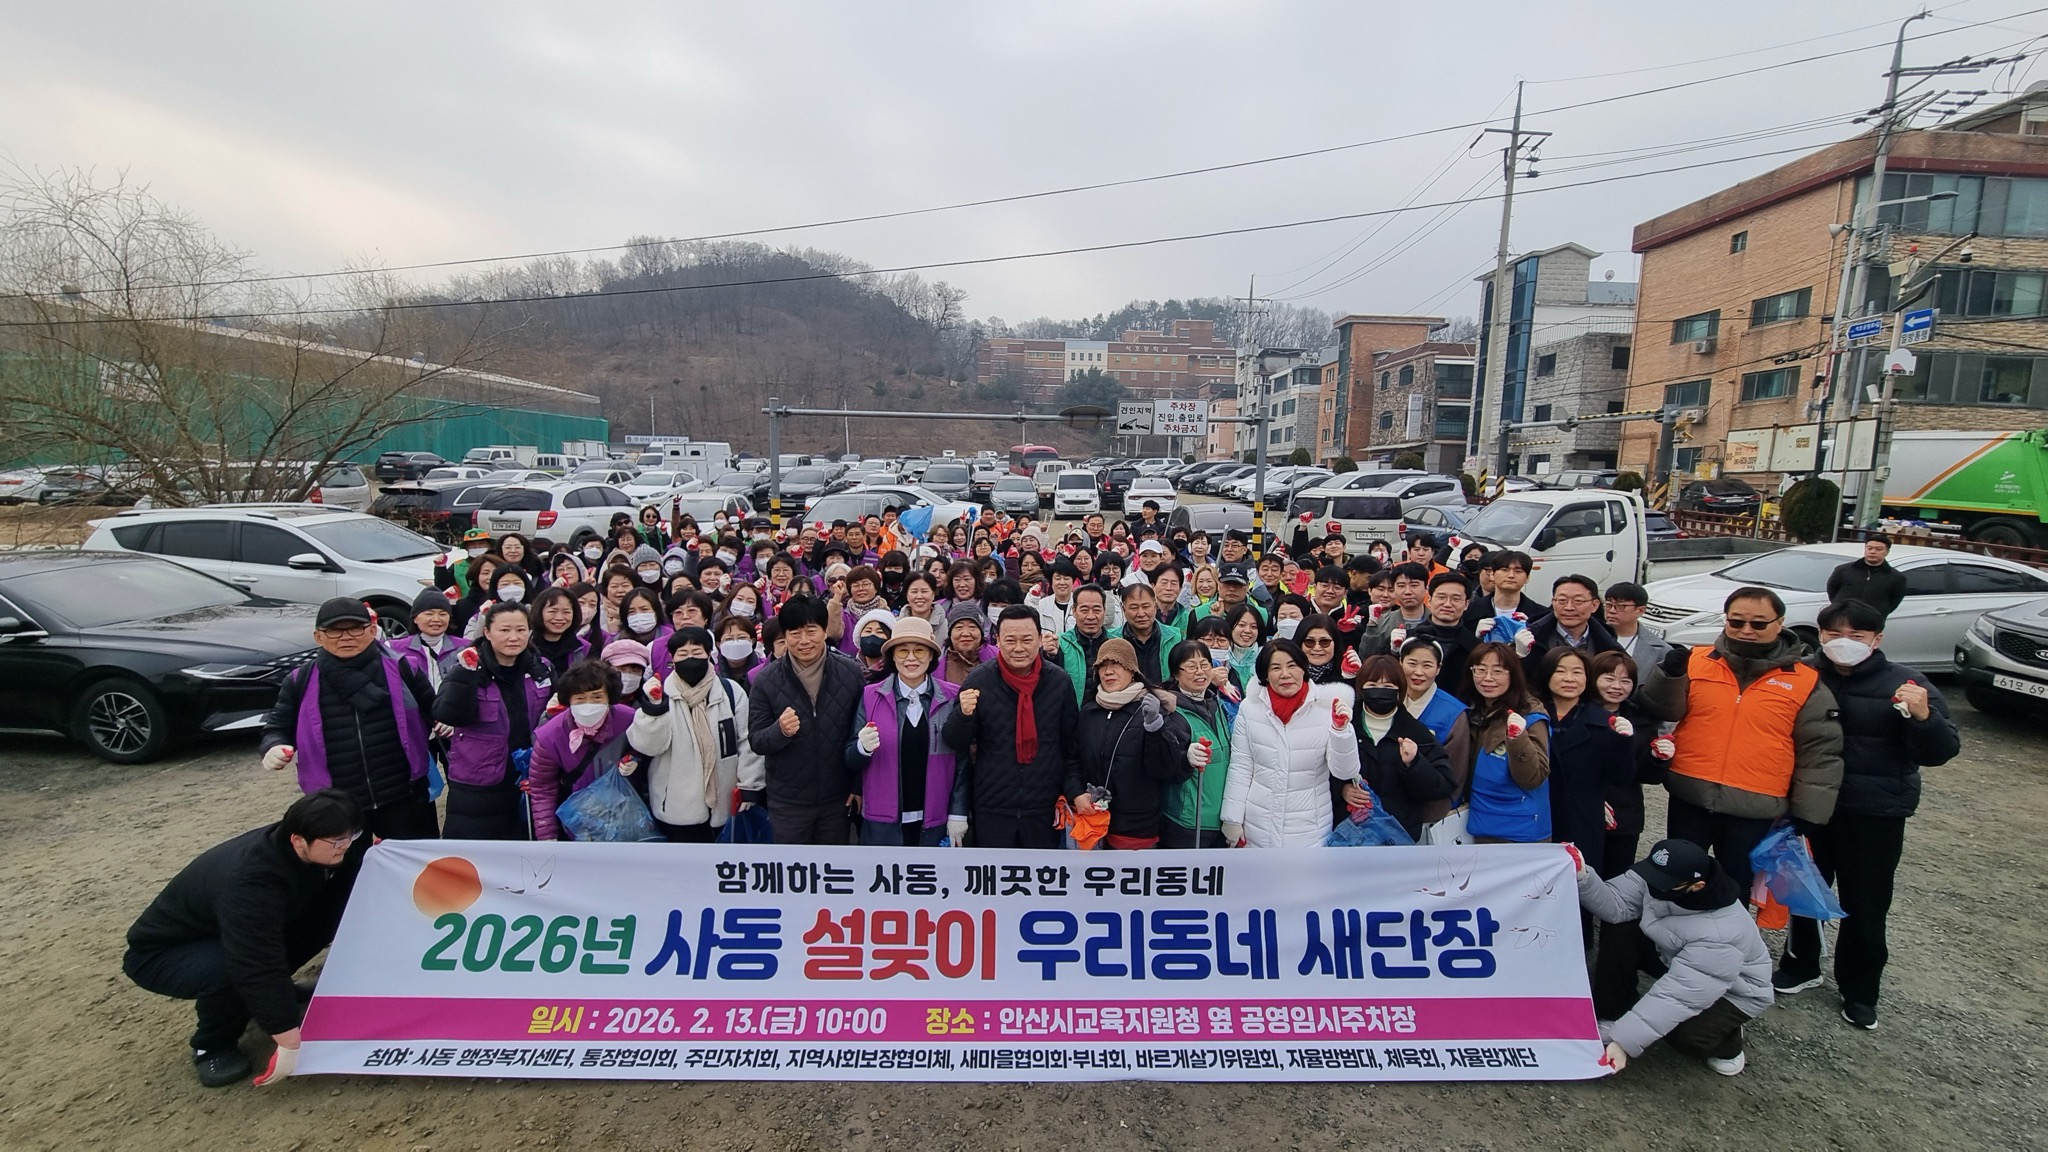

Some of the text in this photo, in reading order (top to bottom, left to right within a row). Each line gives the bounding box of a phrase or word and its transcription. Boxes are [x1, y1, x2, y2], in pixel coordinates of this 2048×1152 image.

[1120, 406, 1152, 415] 견인지역
[1170, 402, 1196, 411] 주차장
[1163, 424, 1198, 433] 주차금지
[2000, 678, 2048, 696] 61모 69
[715, 861, 1225, 899] 함께하는 사동, 깨끗한 우리동네
[420, 906, 1500, 981] 2026년 사동 설맞이 우리동네 새단장
[603, 1008, 681, 1034] 2026.
[689, 1008, 714, 1034] 2.
[724, 1007, 807, 1036] 13.(금)
[815, 1007, 888, 1035] 10:00
[999, 1007, 1201, 1035] 안산시교육지원청
[1208, 1007, 1234, 1035] 옆
[1240, 1007, 1417, 1035] 공영임시주차장
[363, 1048, 412, 1068] 참여:
[412, 1049, 457, 1067] 사동
[456, 1048, 574, 1069] 행정복지센터,
[579, 1048, 678, 1069] 통장협의회,
[684, 1049, 781, 1070] 주민자치회,
[786, 1049, 955, 1071] 지역사회보장협의체,
[1135, 1049, 1285, 1070] 바르게살기위원회,
[1286, 1048, 1383, 1070] 자율방범대,
[1386, 1048, 1446, 1070] 체육회,
[1448, 1047, 1540, 1068] 자율방재단
